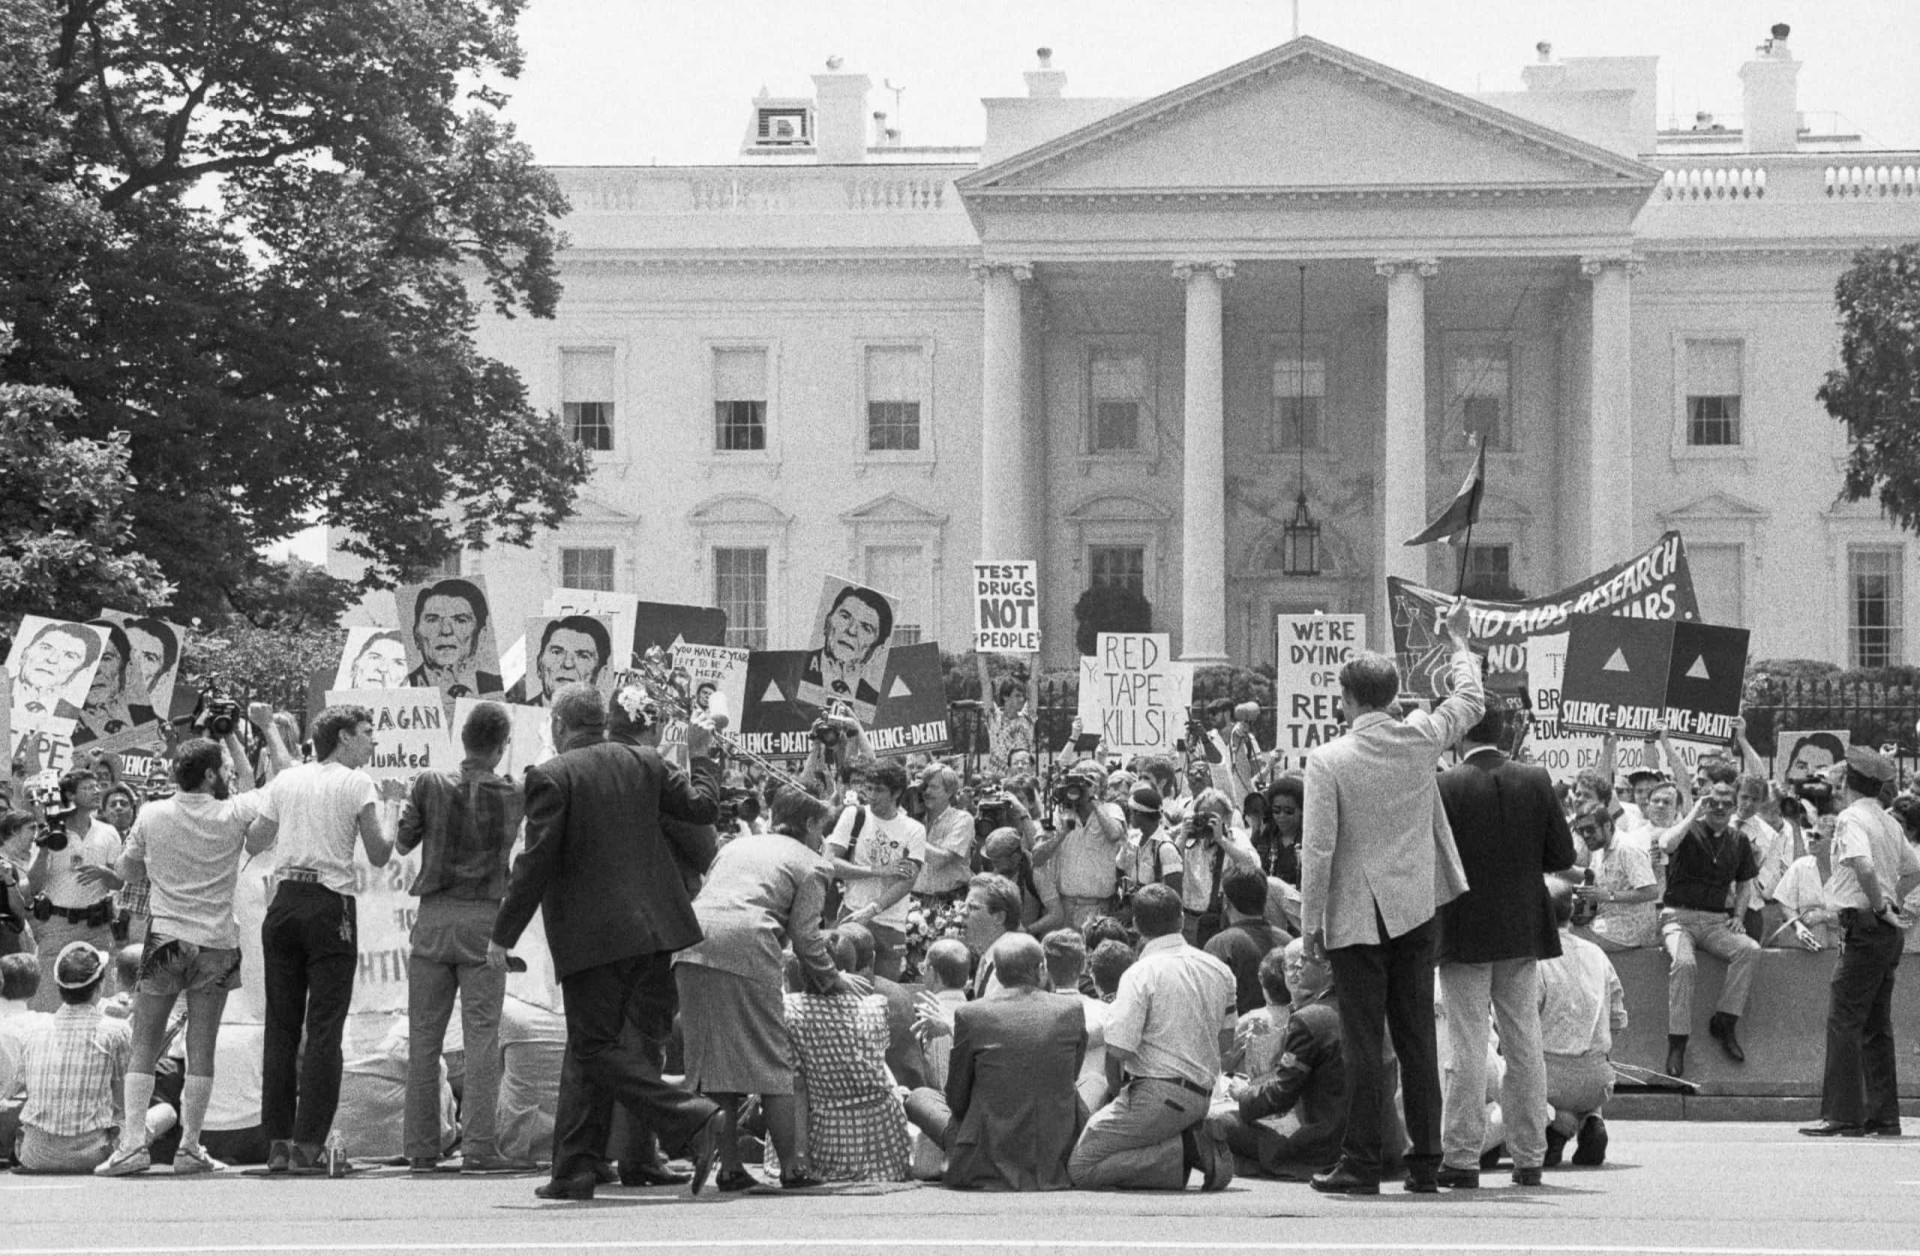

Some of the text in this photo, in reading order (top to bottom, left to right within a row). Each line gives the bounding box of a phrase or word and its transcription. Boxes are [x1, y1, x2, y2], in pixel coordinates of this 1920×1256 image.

[974, 565, 1029, 579] TEST
[978, 580, 1035, 597] DRUGS
[1434, 535, 1680, 638] FND AIDS RESEARCH
[980, 598, 1035, 629] NOT
[980, 632, 1036, 648] PEOPLE
[1291, 621, 1355, 641] WE'RE
[675, 645, 692, 656] YOU
[694, 647, 718, 658] HAVE
[719, 650, 727, 659] 2
[1106, 636, 1158, 670] RED
[724, 660, 733, 670] A
[1310, 671, 1335, 687] OF
[1103, 673, 1164, 706] TAPE
[1560, 700, 1659, 731] SILENCE=DEATH
[1103, 708, 1166, 747] KILLS!
